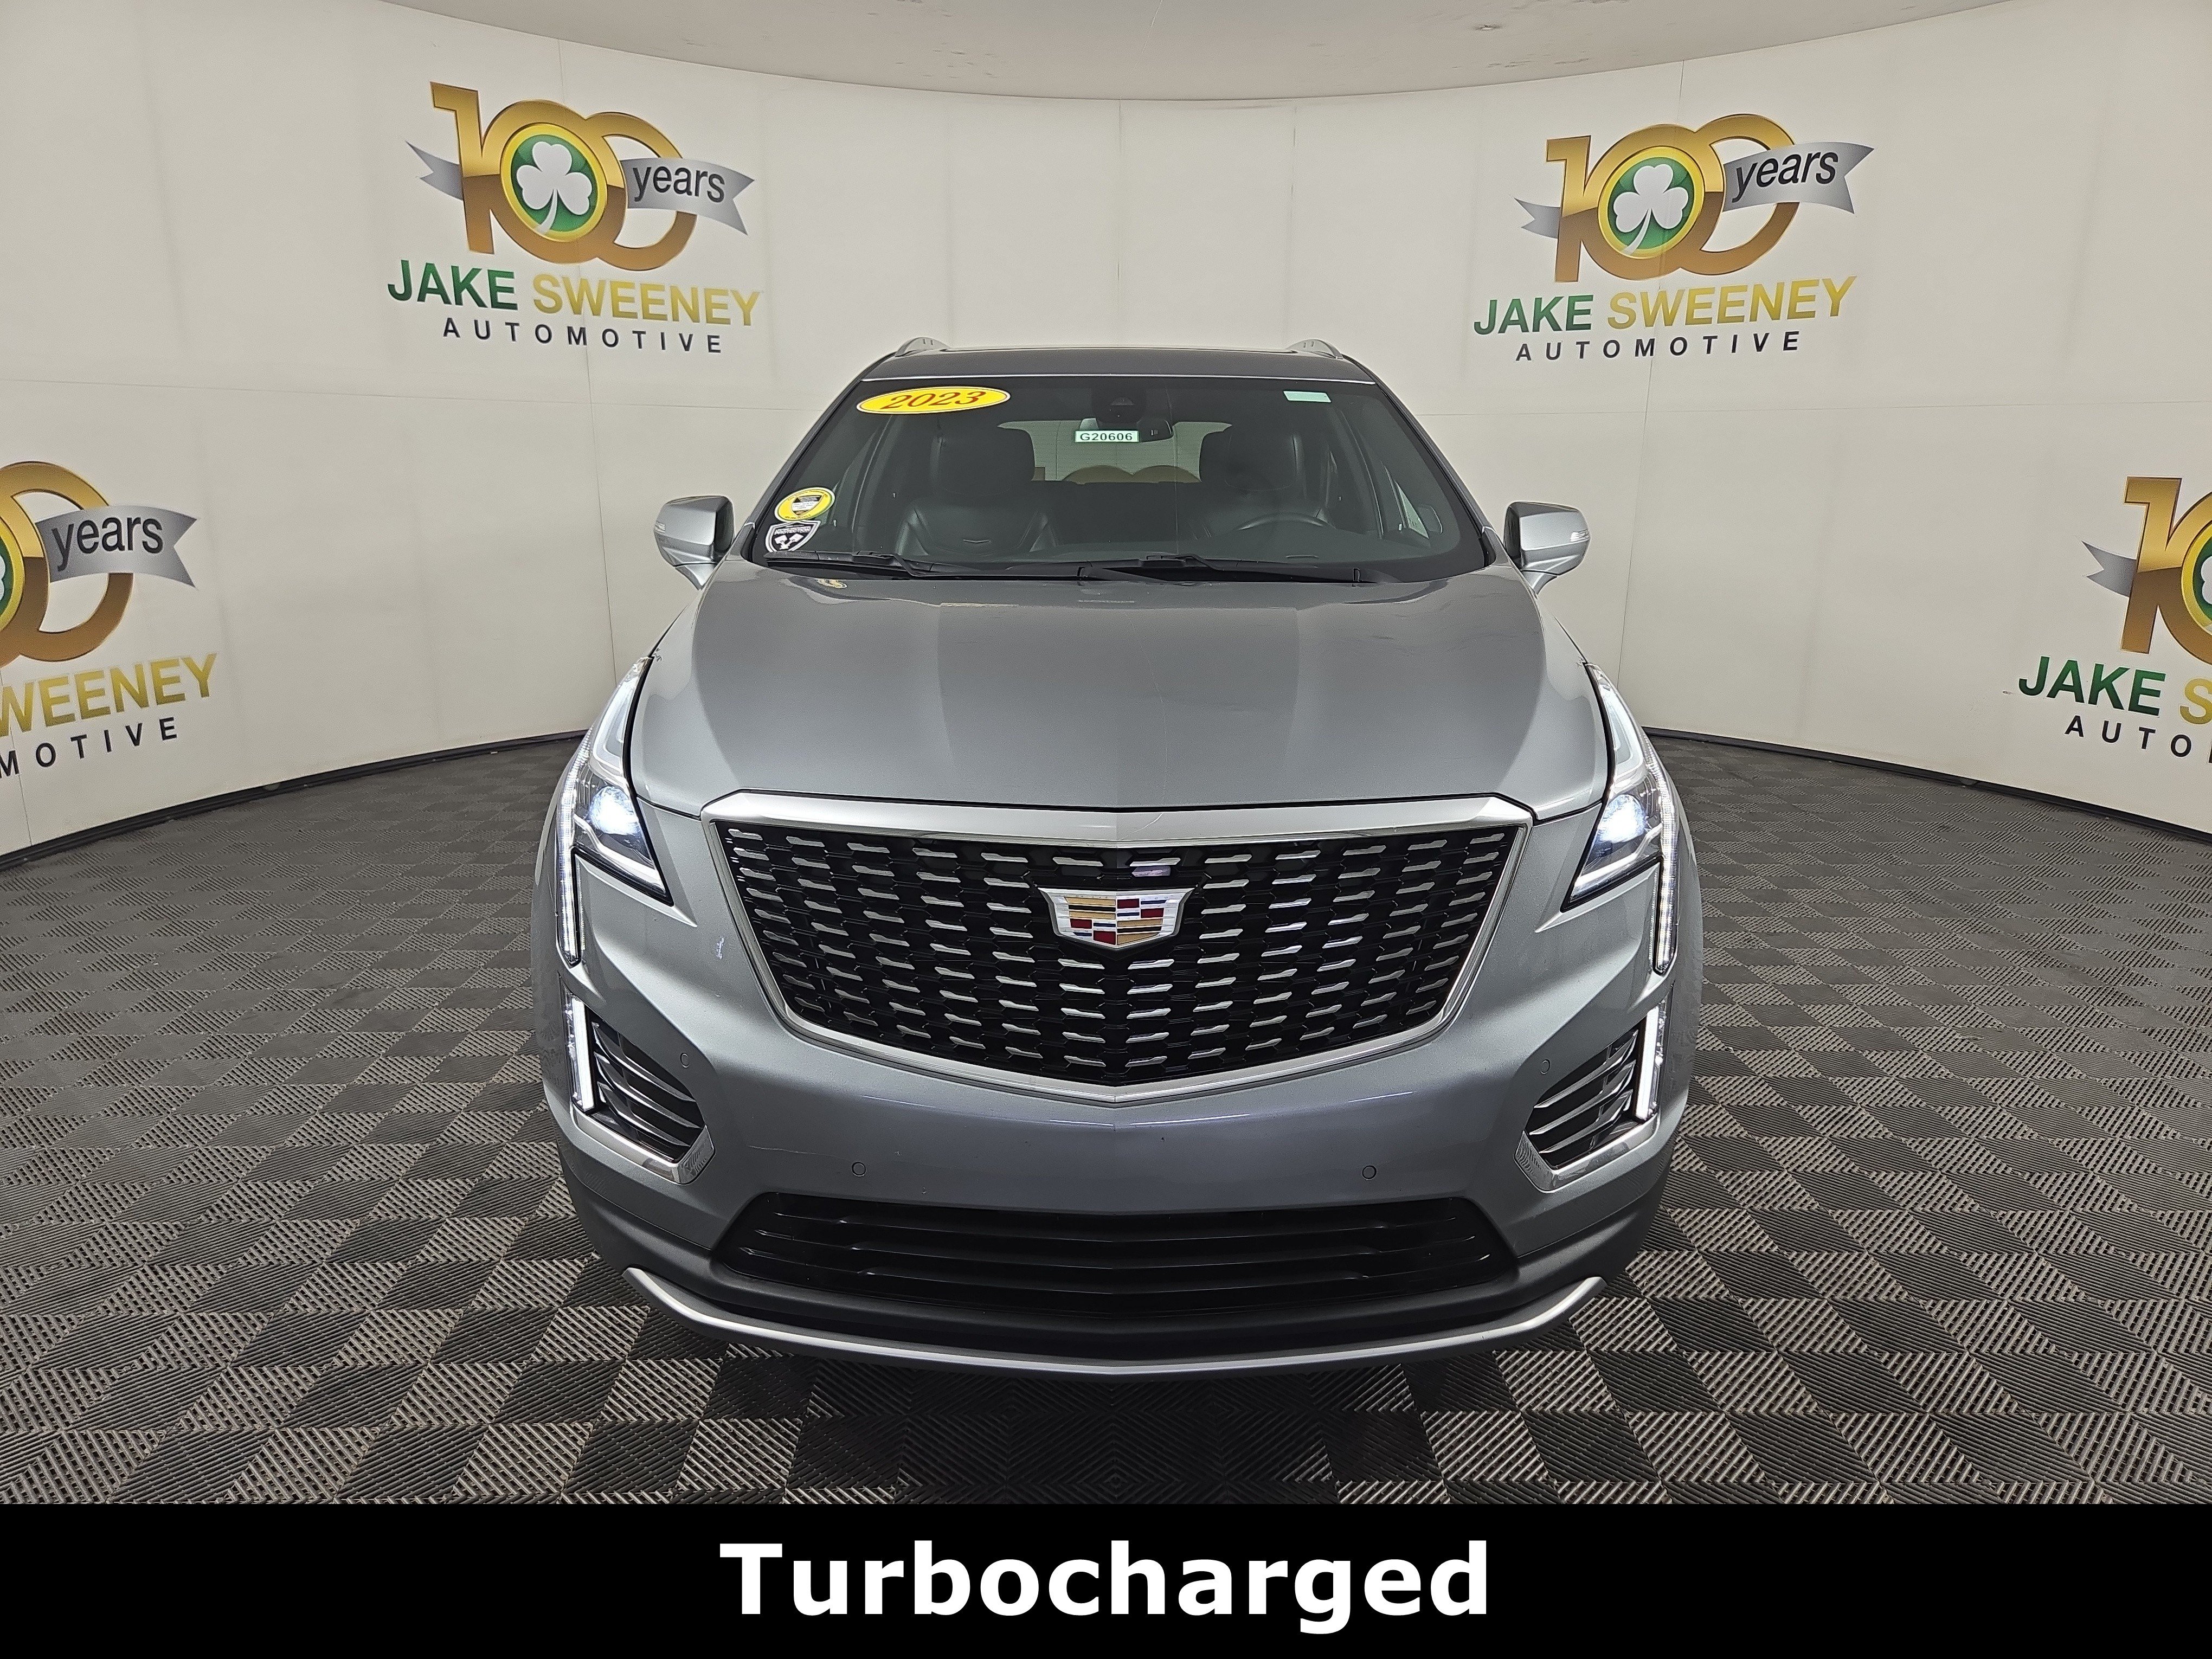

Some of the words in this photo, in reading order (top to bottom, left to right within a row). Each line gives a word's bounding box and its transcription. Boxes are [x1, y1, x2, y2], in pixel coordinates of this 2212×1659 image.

[430, 81, 698, 271] 100
[633, 165, 725, 203] years
[1546, 113, 1801, 283] 100
[1732, 151, 1838, 203] years
[387, 259, 518, 311] JAKE
[533, 274, 761, 326] SWEENEY
[1474, 294, 1594, 335] JAKE
[1607, 275, 1857, 330] SWEENEY
[443, 317, 722, 353] AUTOMOTIVE
[1515, 331, 1800, 361] AUTOMOTIVE
[880, 391, 986, 409] 2023
[1080, 433, 1133, 441] G20606
[52, 516, 163, 571] years
[2018, 655, 2166, 716] JAKE
[2065, 715, 2212, 763] AUTO
